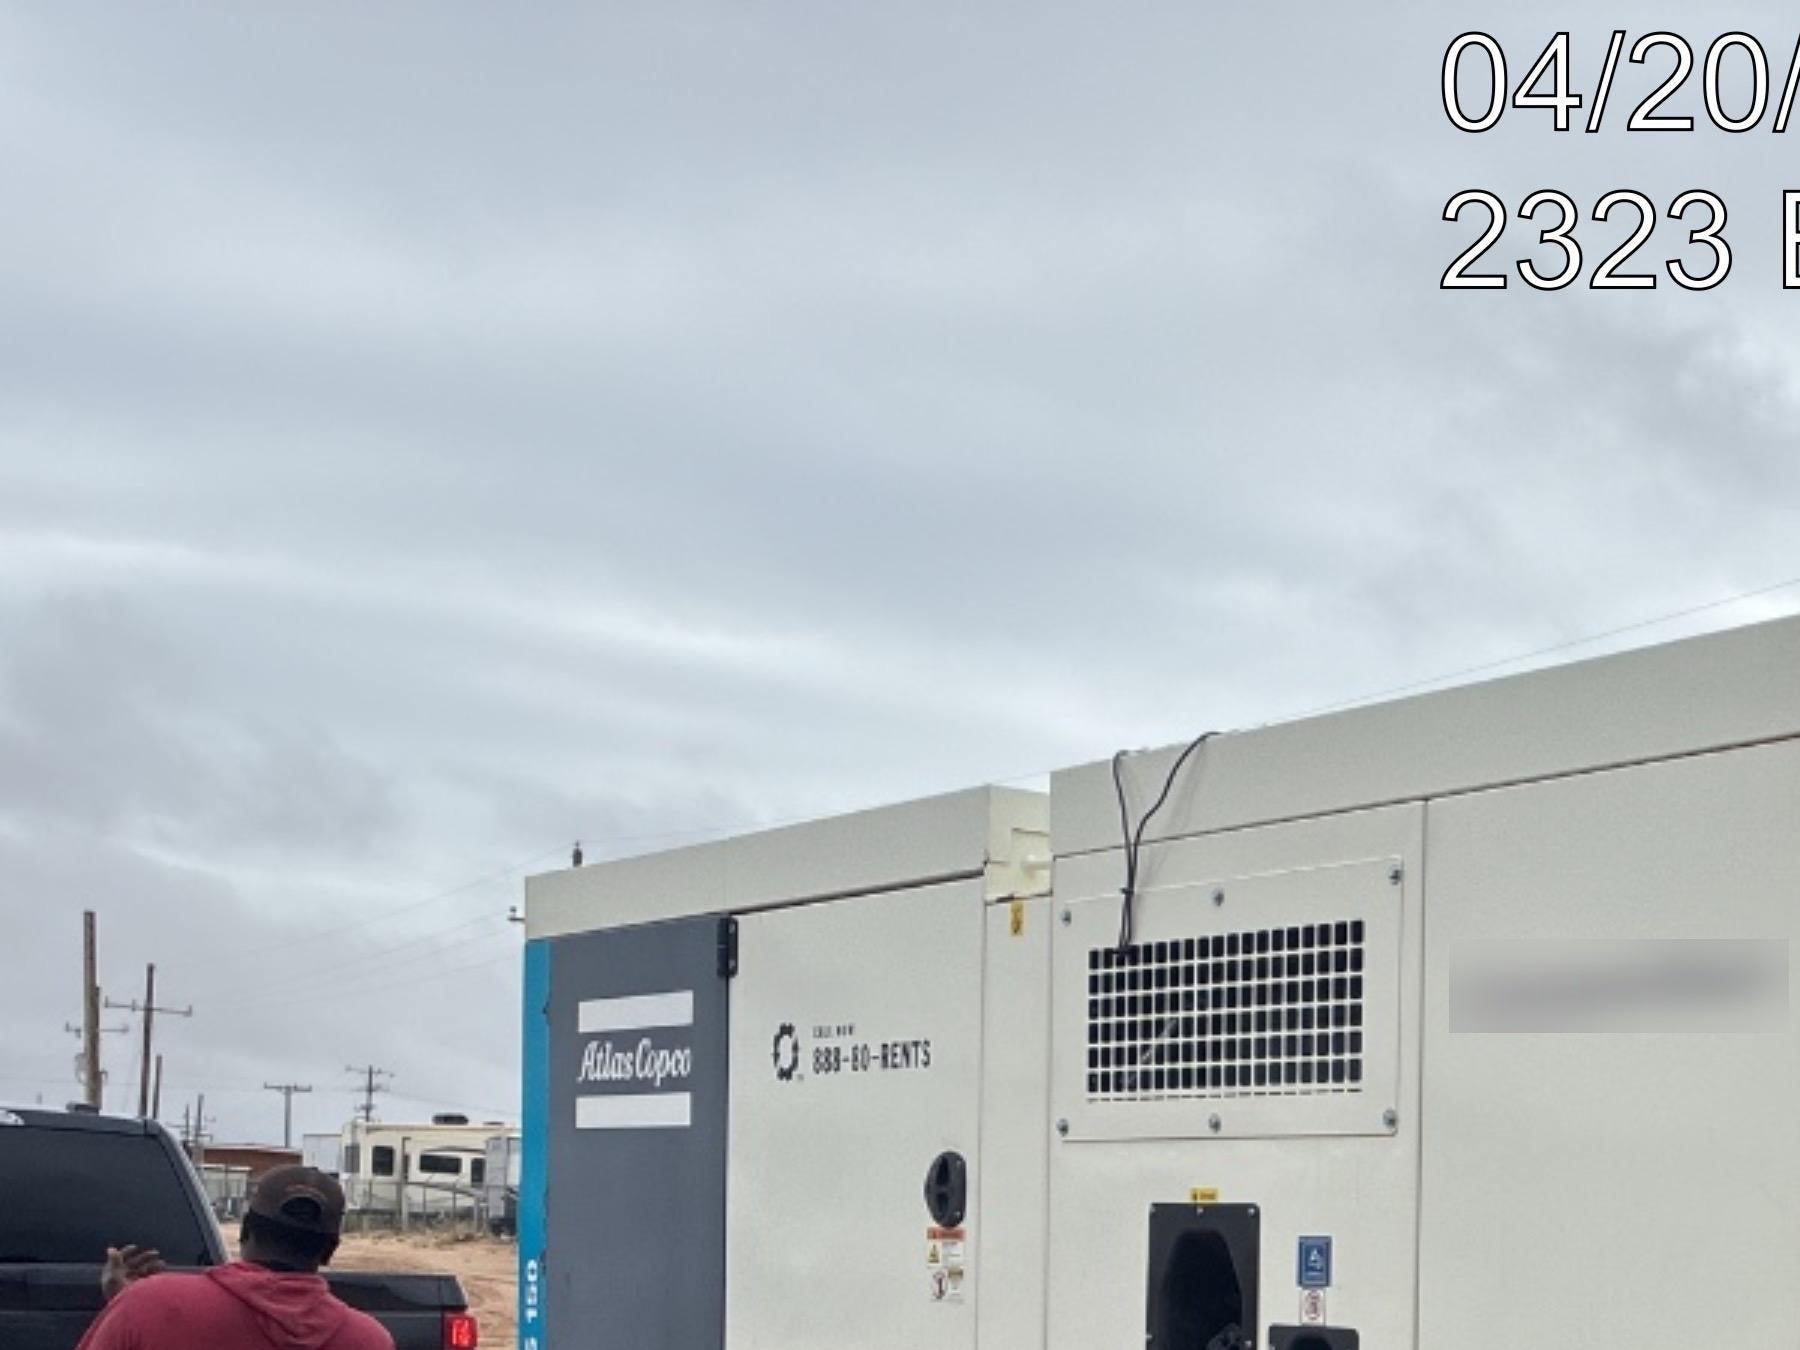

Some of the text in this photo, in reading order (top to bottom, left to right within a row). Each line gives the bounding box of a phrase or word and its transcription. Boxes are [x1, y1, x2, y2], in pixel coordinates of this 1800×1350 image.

[577, 1037, 691, 1087] Atlas Copco
[525, 1258, 538, 1325] 150
